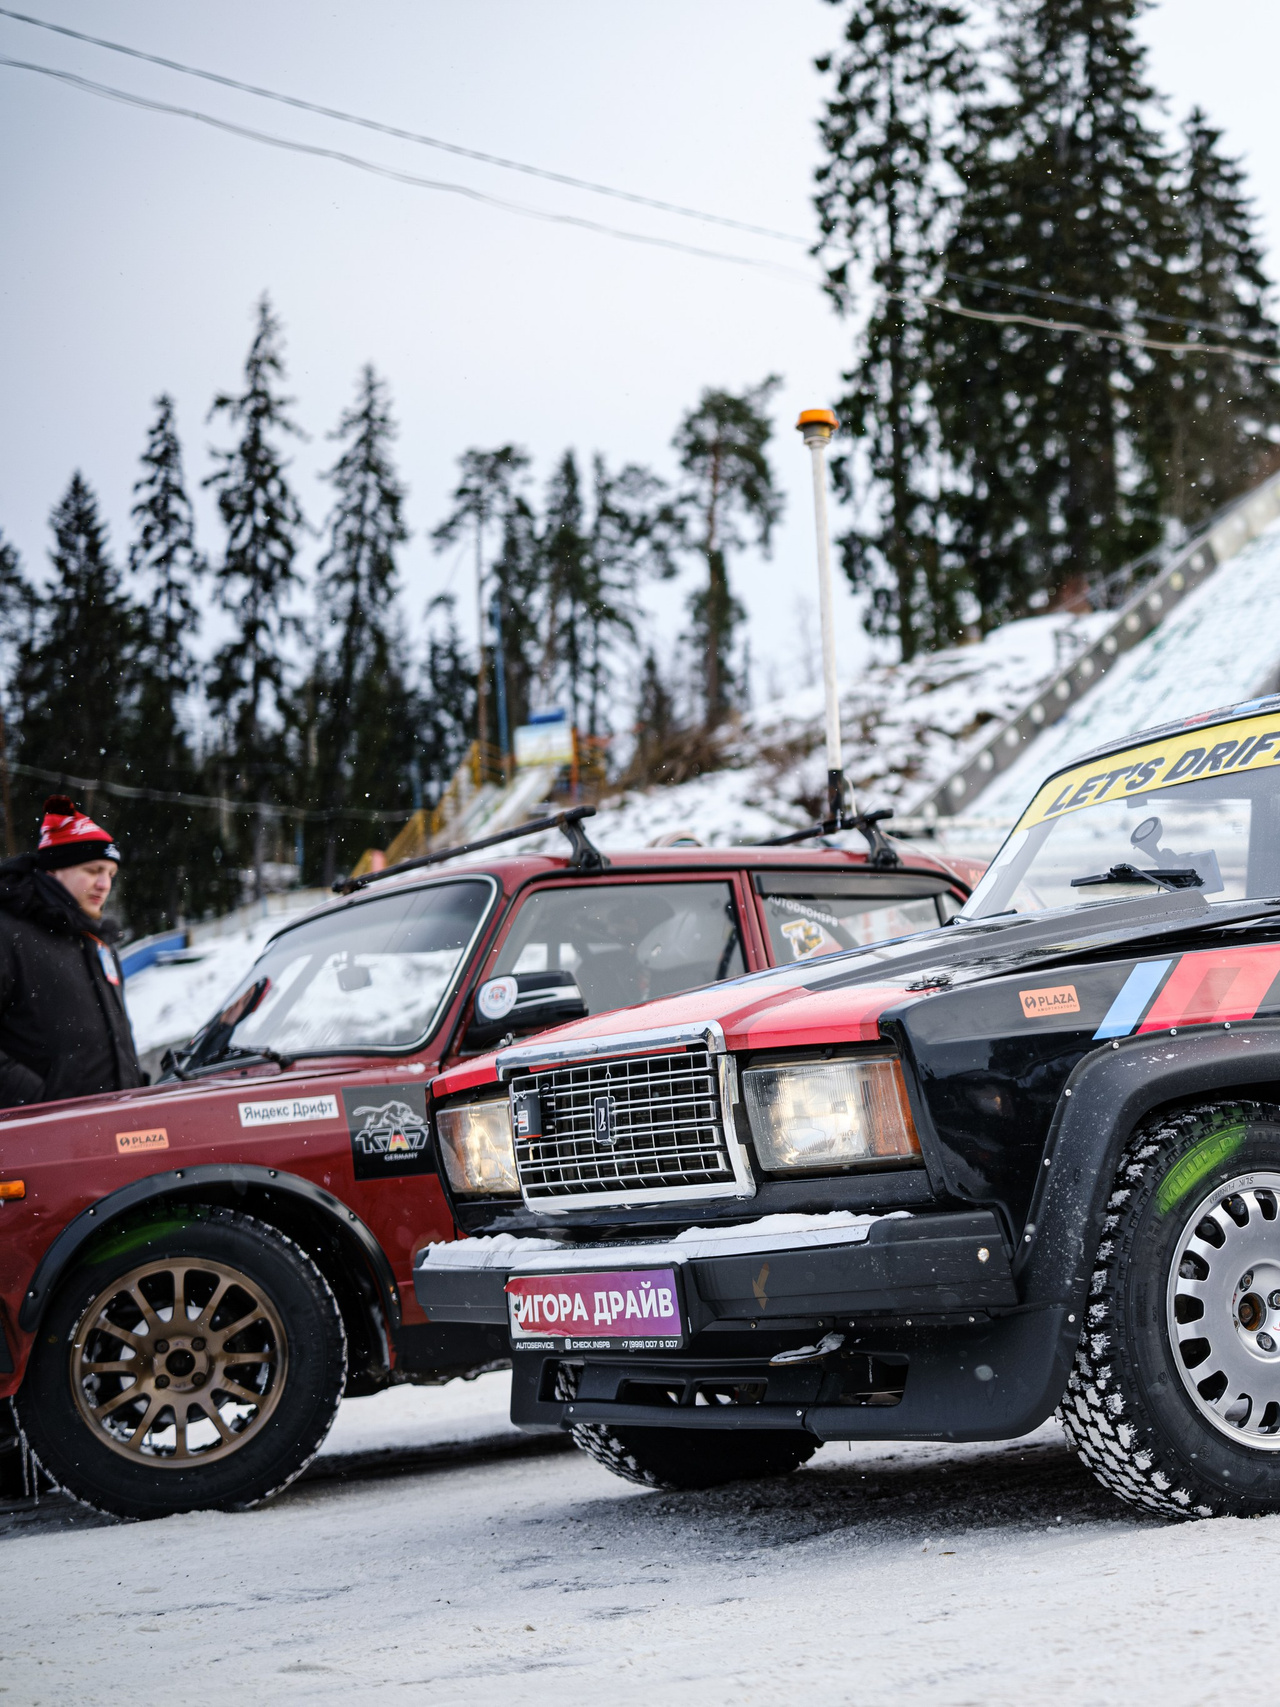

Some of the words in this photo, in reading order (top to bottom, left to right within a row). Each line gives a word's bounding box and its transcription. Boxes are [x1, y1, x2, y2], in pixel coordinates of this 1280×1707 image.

[1043, 757, 1164, 817] LET'S
[1037, 992, 1075, 1007] PLAZA
[244, 1105, 289, 1120] Яндекс
[293, 1101, 334, 1118] Дрифт
[131, 1133, 165, 1145] PLAZA
[384, 1151, 419, 1161] GERMANY
[518, 1292, 589, 1323] ИГОРА
[594, 1280, 674, 1325] ДРАЙВ
[516, 1341, 555, 1349] AUTOSERVICE
[622, 1340, 628, 1348] +7
[645, 1340, 657, 1348] 007
[665, 1340, 678, 1348] 007
